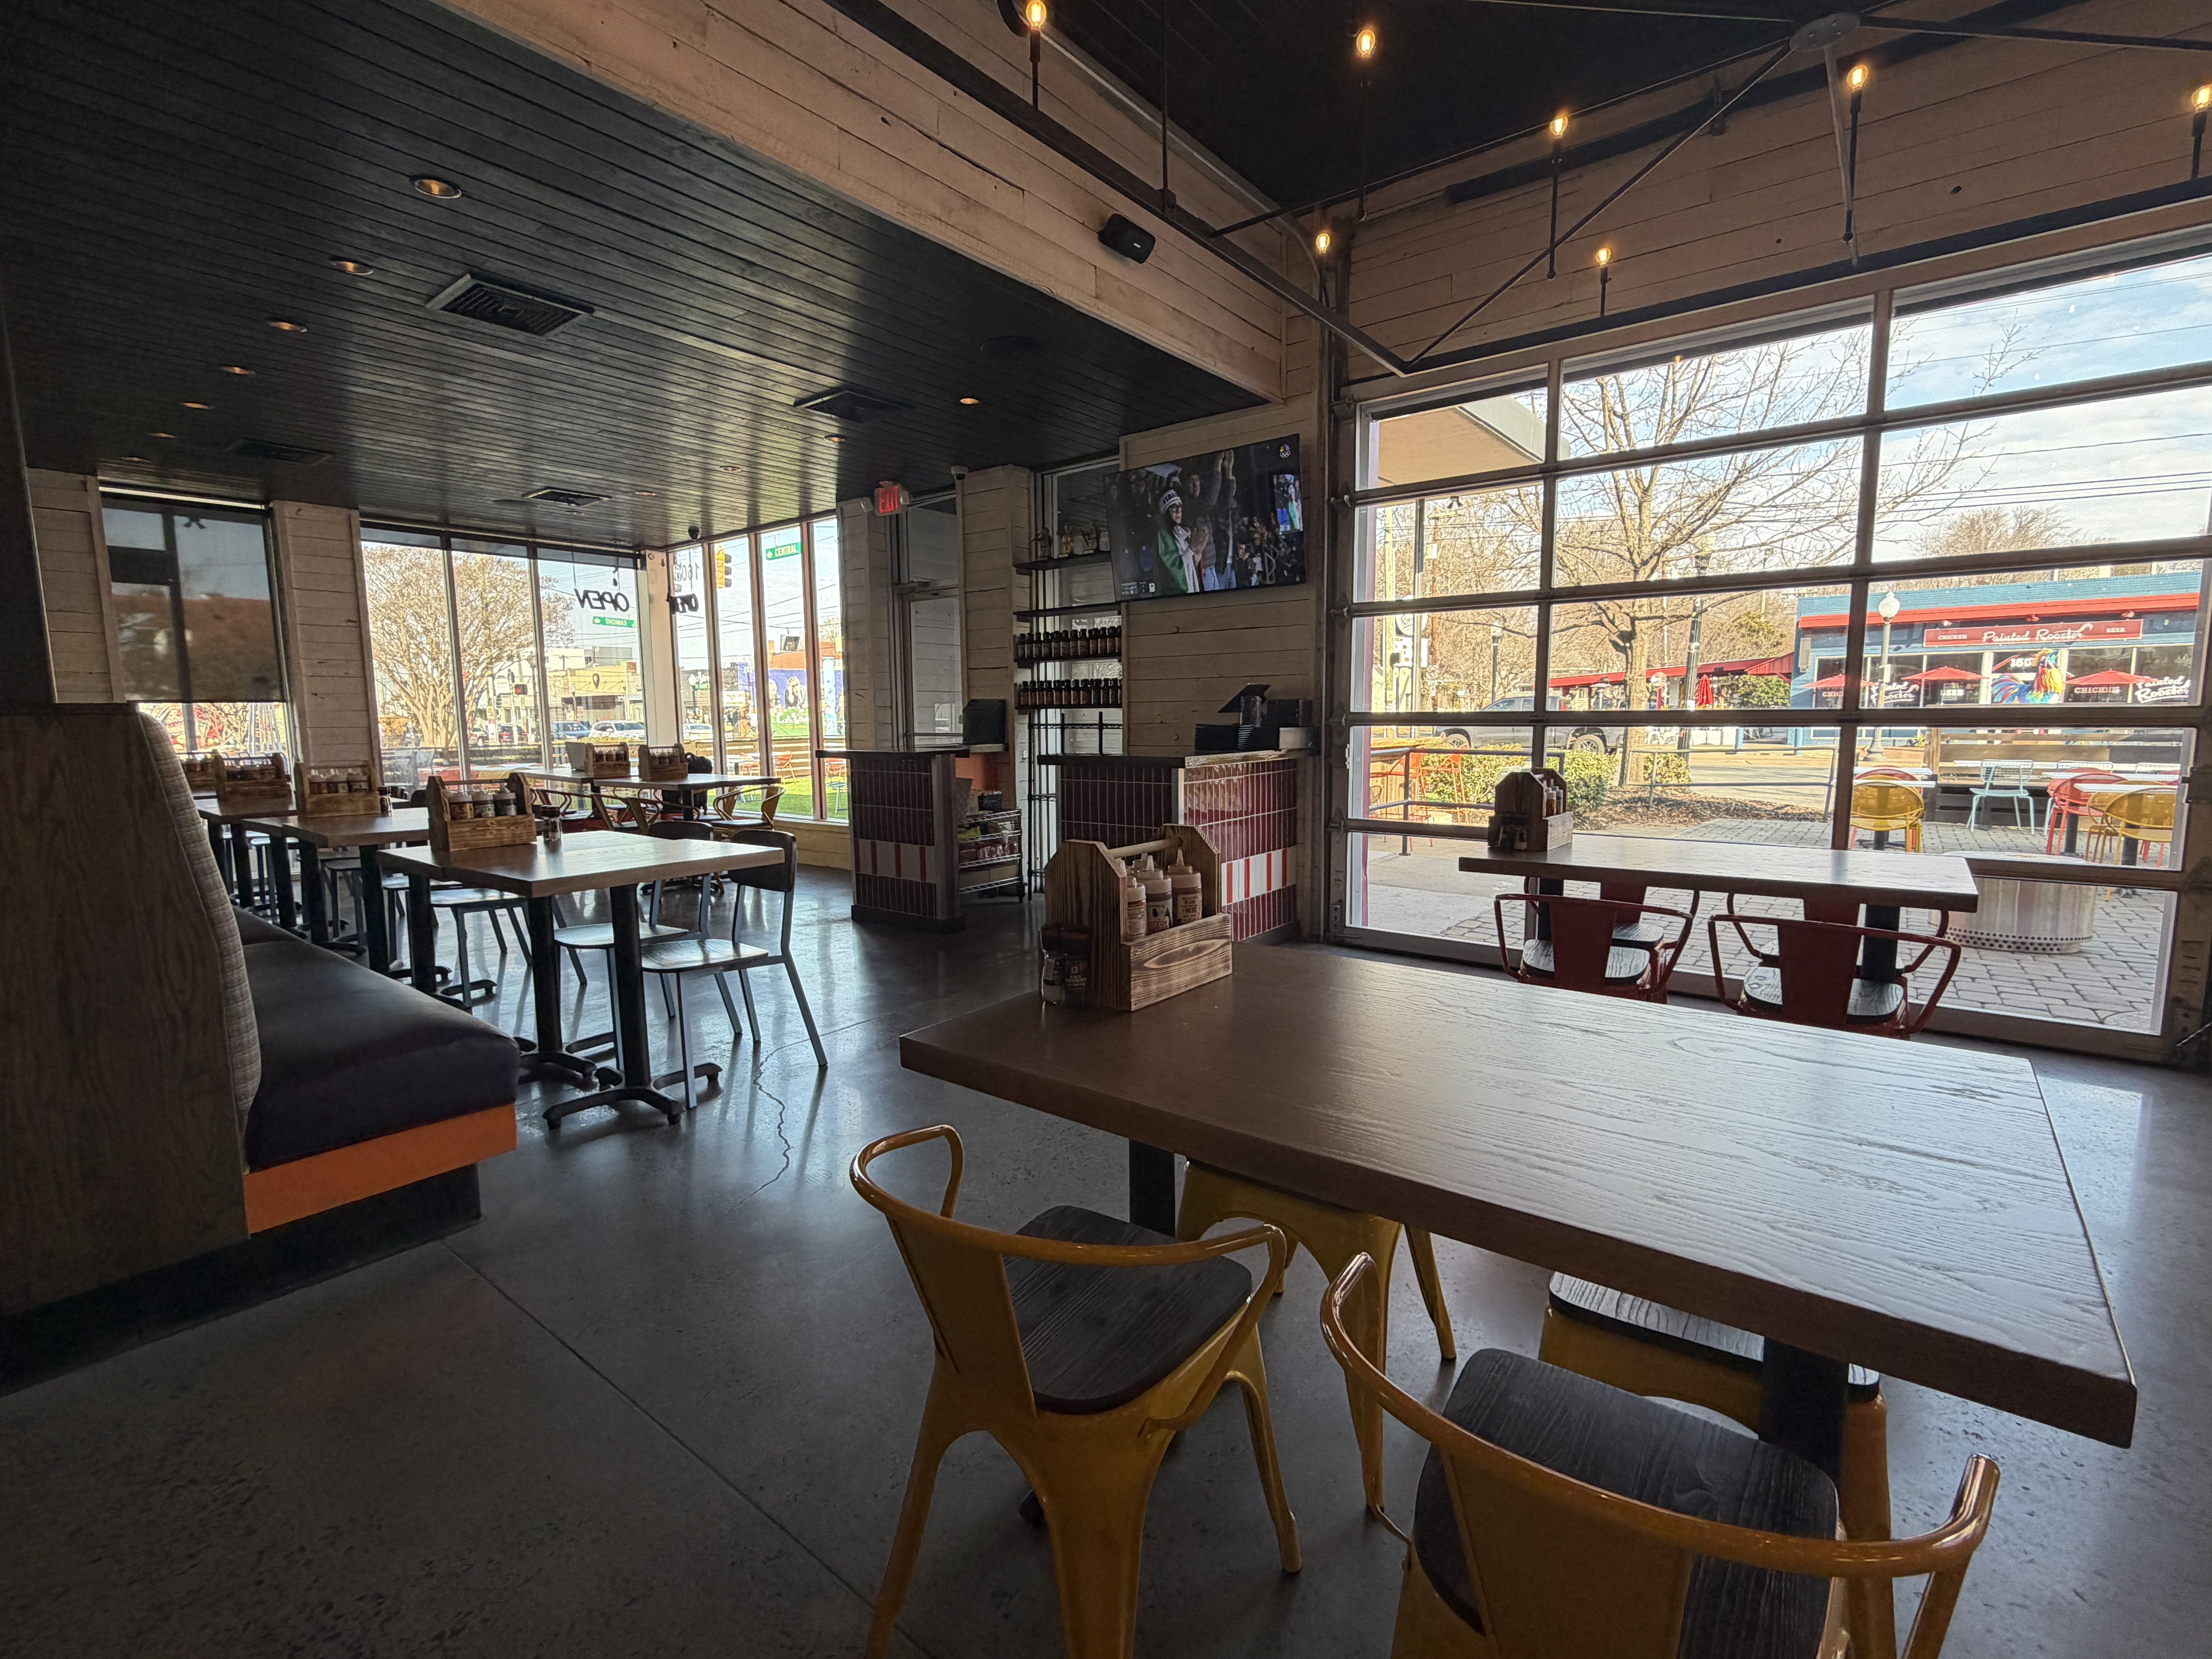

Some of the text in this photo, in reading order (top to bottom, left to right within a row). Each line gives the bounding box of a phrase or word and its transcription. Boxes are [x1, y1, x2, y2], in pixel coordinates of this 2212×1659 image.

[879, 486, 898, 513] EXIT
[1163, 492, 1177, 505] ITAL
[775, 544, 800, 558] CENTRAL
[605, 618, 628, 626] THOMAS
[1982, 630, 2030, 642] Painted
[2035, 623, 2093, 641] Rooster
